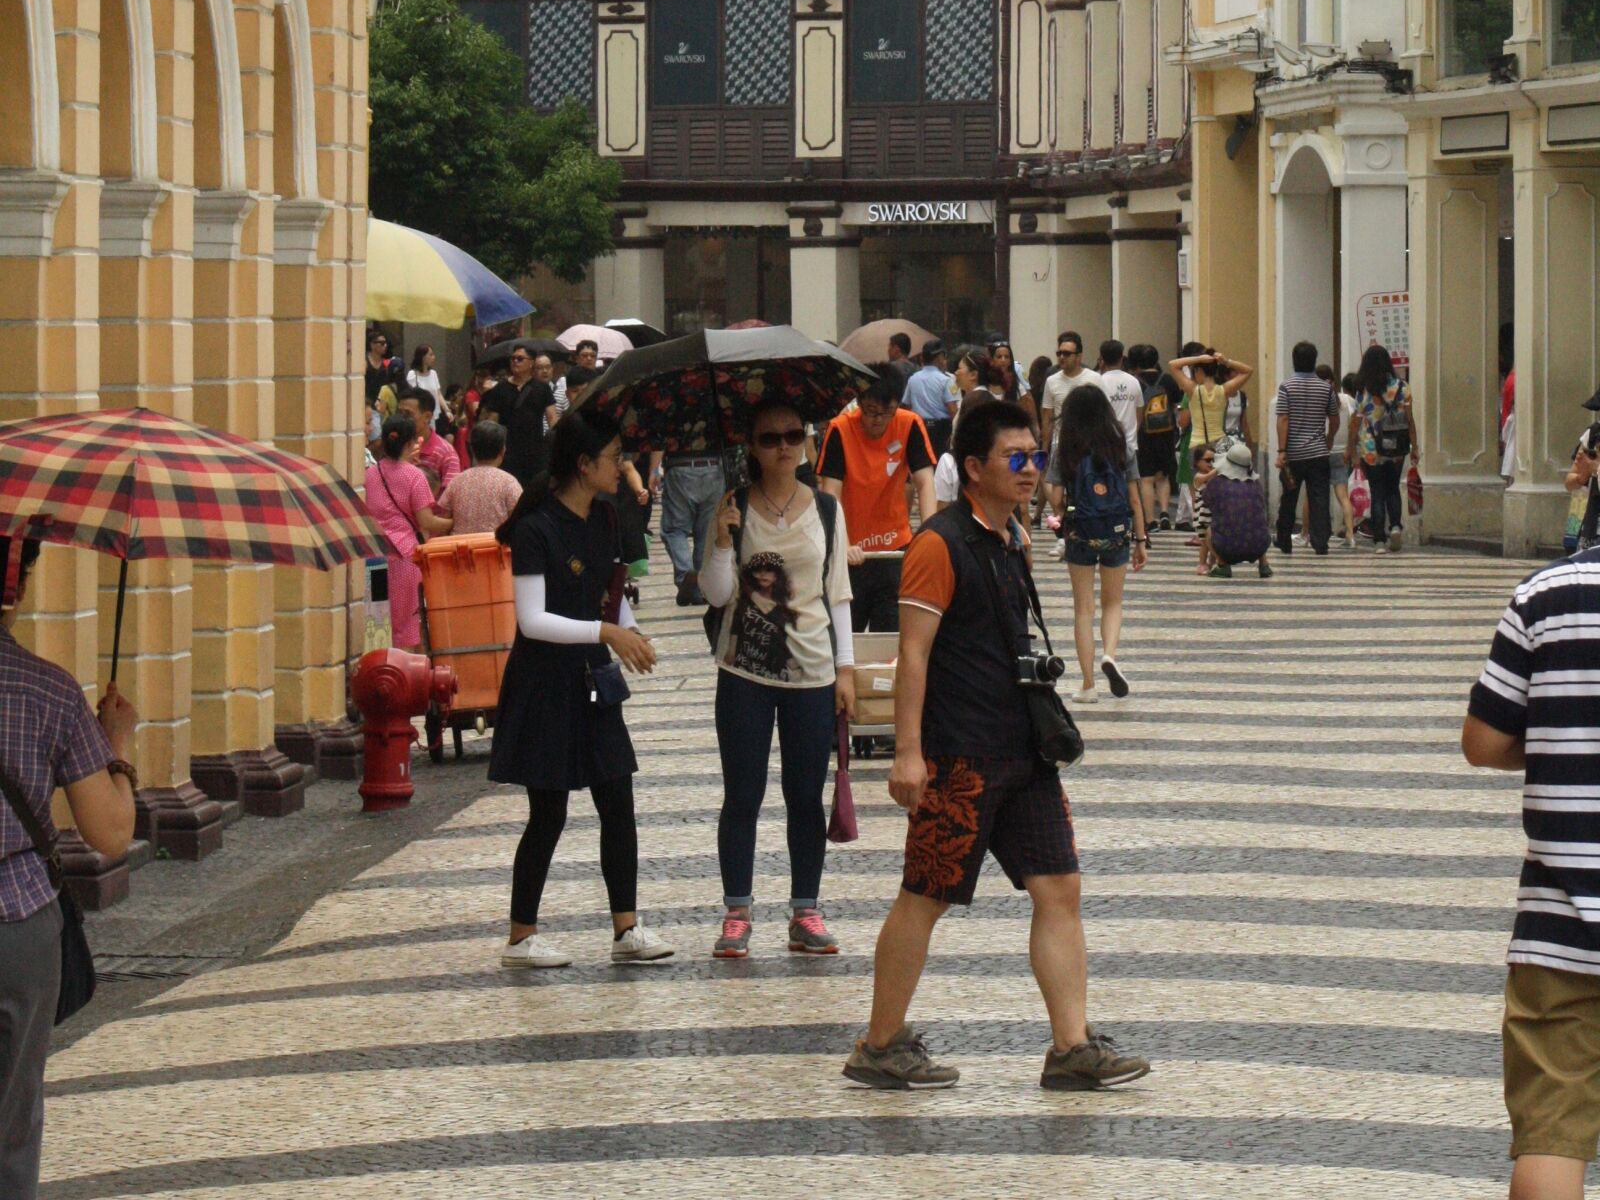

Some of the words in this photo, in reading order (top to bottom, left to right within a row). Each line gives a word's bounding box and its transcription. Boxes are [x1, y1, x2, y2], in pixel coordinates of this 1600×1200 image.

[663, 54, 706, 64] SWAROVSKI
[863, 50, 906, 60] SWAROVSKI
[868, 202, 966, 222] SWAROVSKI
